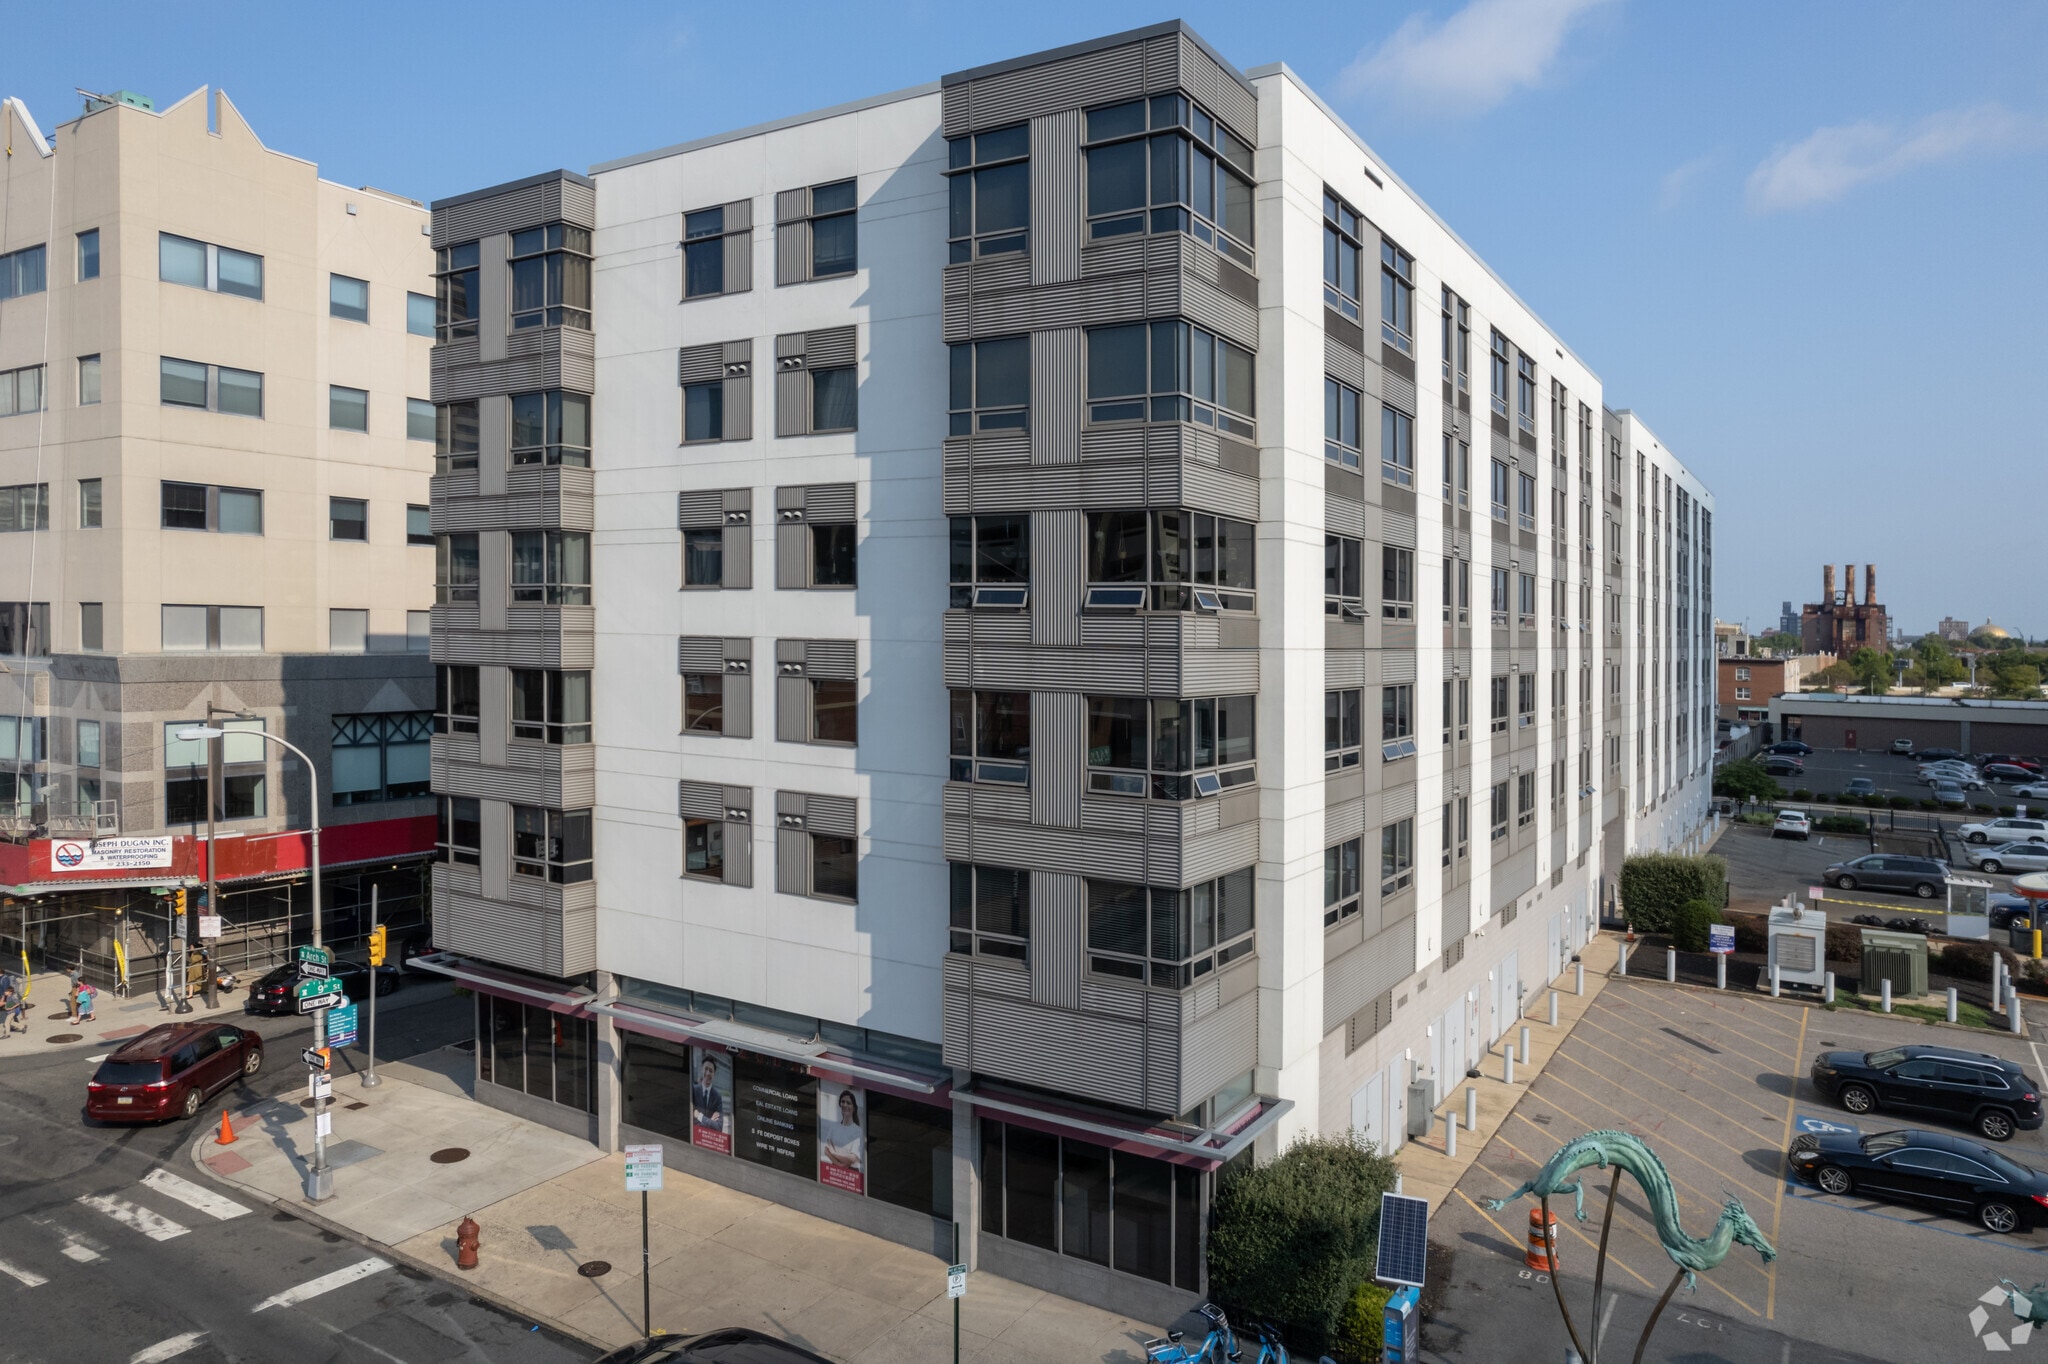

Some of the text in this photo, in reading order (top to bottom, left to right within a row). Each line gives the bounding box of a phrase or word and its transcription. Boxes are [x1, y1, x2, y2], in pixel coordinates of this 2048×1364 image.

[306, 951, 327, 963] Arch St
[318, 997, 330, 1005] WAY
[752, 1084, 798, 1102] COMMERCIAL LOANS
[764, 1102, 782, 1112] ESTATE
[782, 1107, 798, 1117] LOANS
[756, 1114, 794, 1130] ONLINE BANKING
[755, 1141, 768, 1150] WIRE
[763, 1131, 783, 1142] DEPOSIT
[783, 1137, 800, 1147] BOXES
